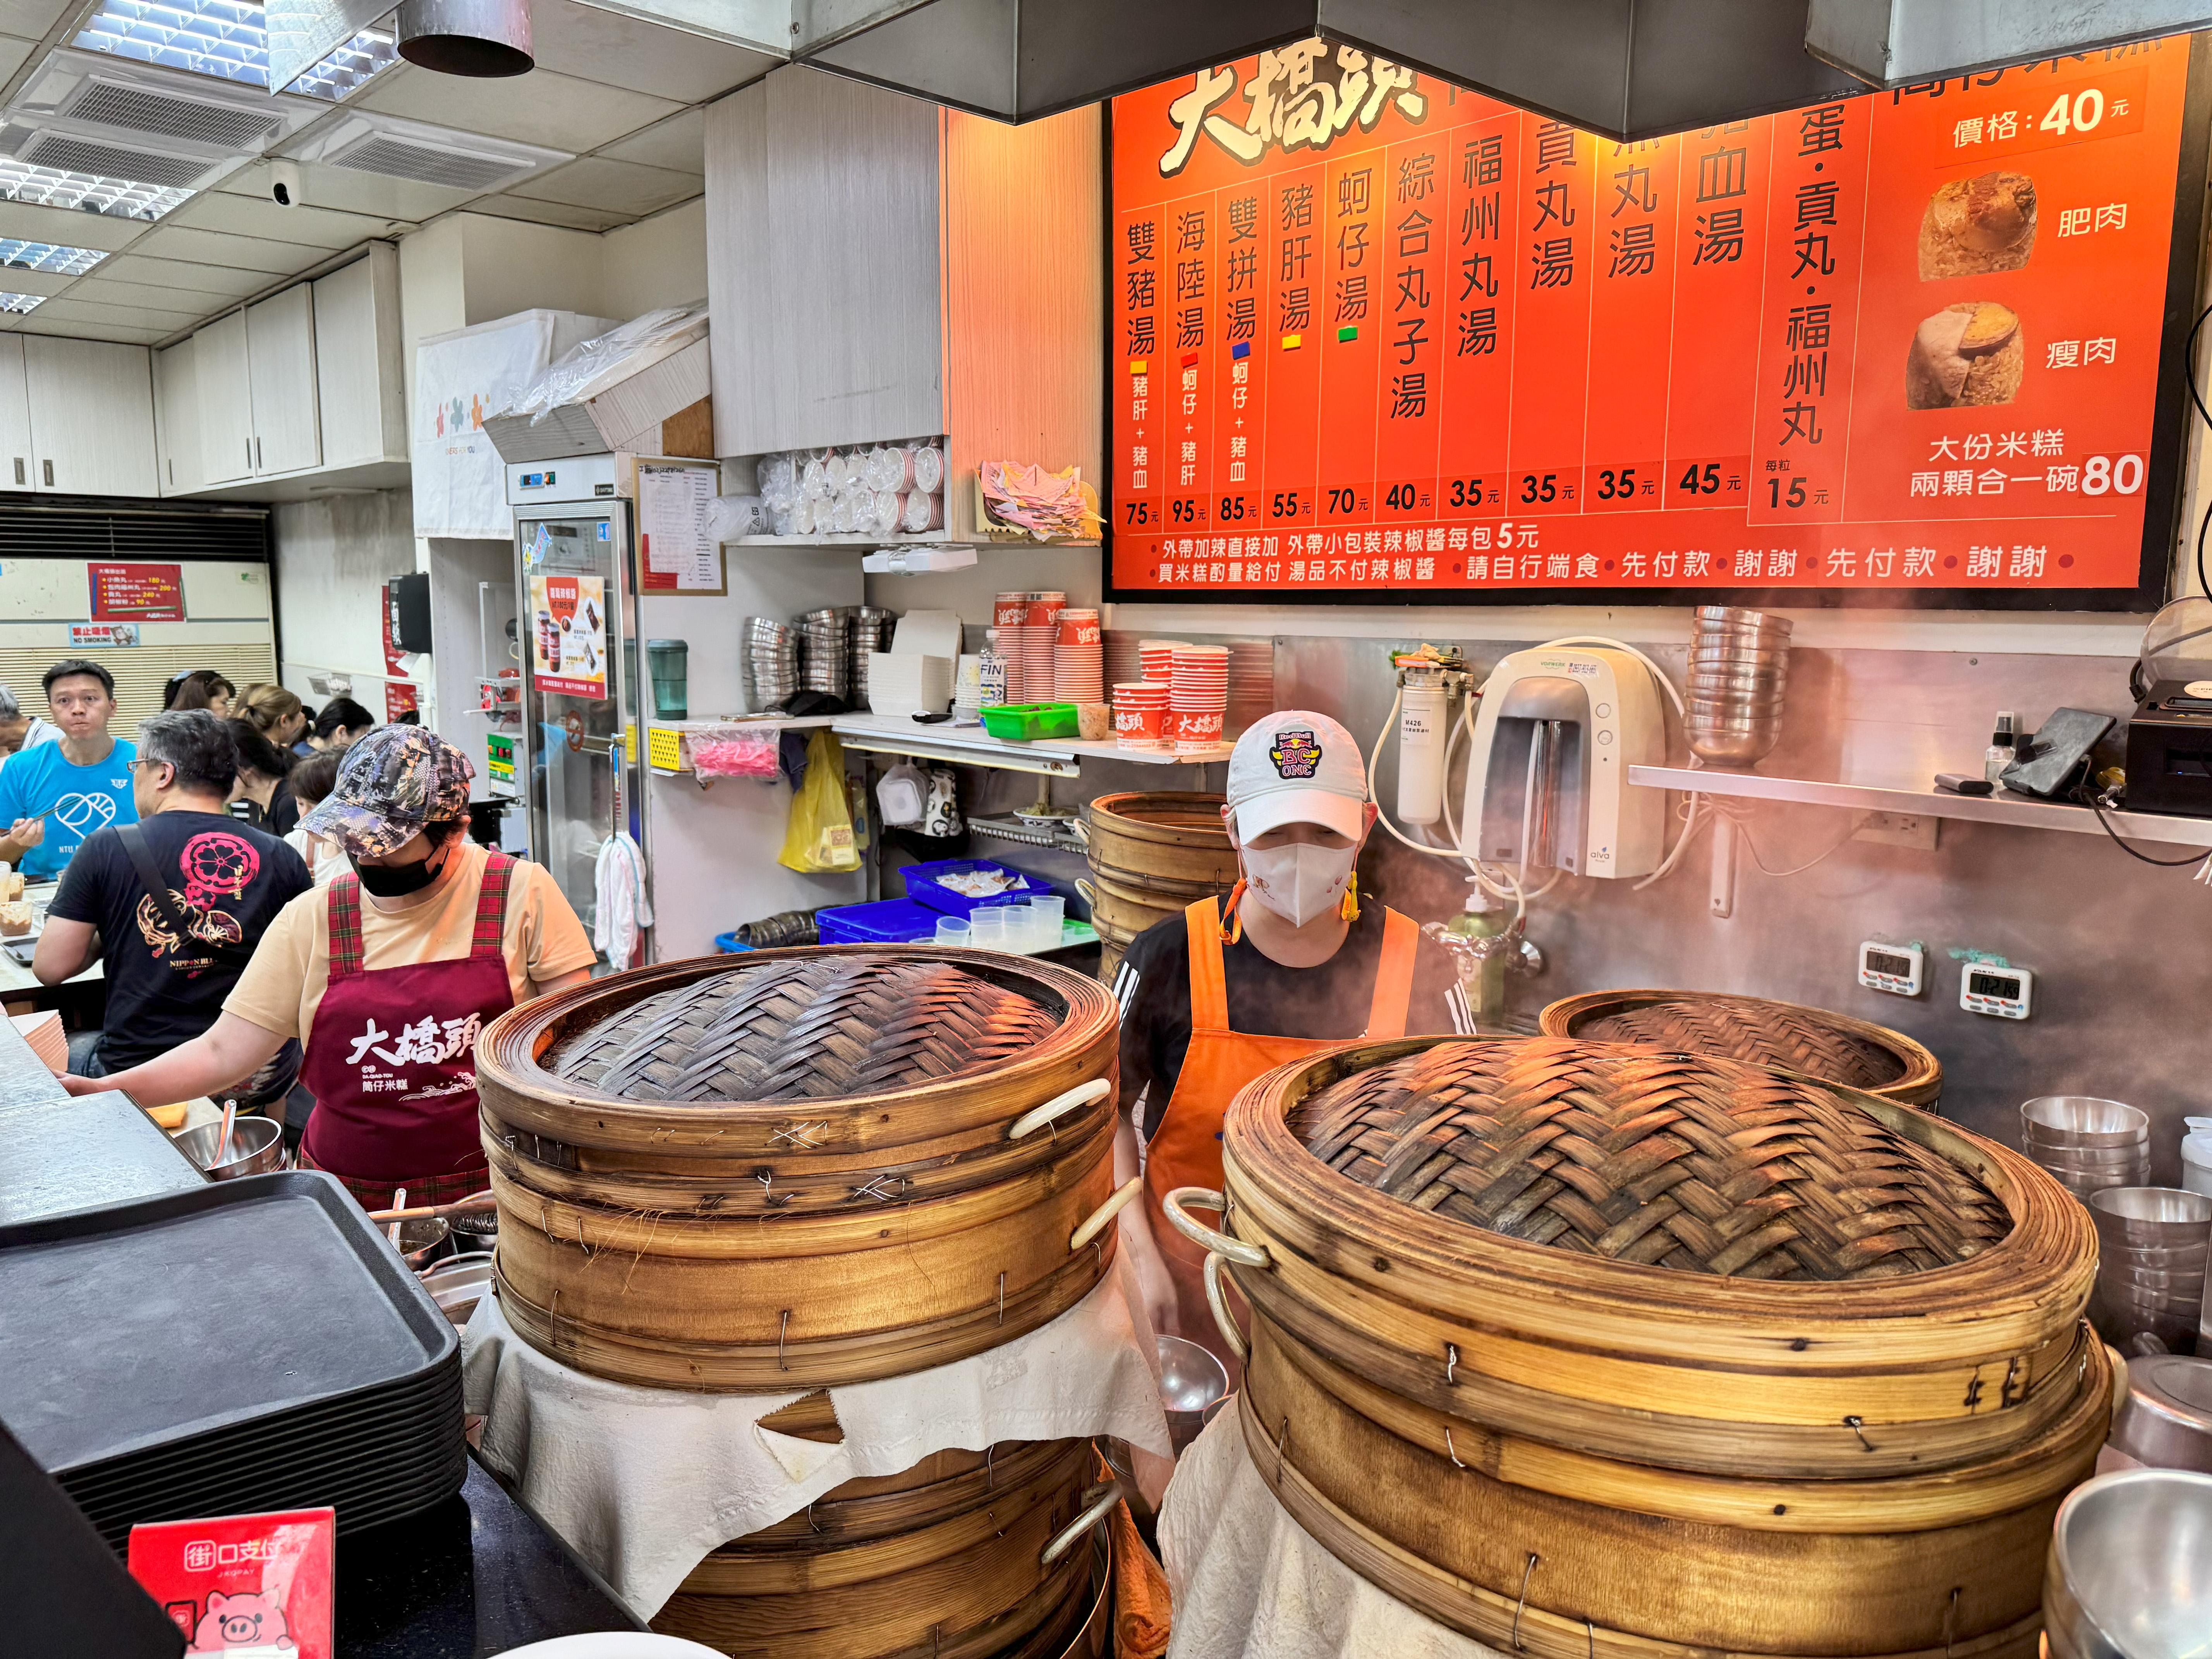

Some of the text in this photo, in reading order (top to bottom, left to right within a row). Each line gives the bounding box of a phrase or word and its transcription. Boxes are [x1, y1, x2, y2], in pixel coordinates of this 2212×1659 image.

[1160, 36, 1424, 173] 大橋頭
[1279, 183, 1313, 332] 豬肝湯
[1334, 168, 1372, 322] 蚵仔湯
[1457, 135, 1502, 357] 福州丸湯
[1530, 121, 1577, 290] 貢丸湯
[1608, 137, 1659, 278] 丸湯
[1693, 118, 1749, 266] 血湯
[2057, 203, 2126, 237] 肥肉
[1127, 221, 1155, 356] 雙豬湯
[1176, 211, 1205, 349] 海陸湯
[1226, 197, 1258, 341] 雙拼湯
[1390, 153, 1436, 419] 綜合丸子湯
[2045, 337, 2116, 369] 瘦肉
[1766, 460, 1790, 472] 每粒
[1929, 429, 2064, 462] 大份米糕
[1159, 545, 2047, 582] 買米糕酌量給付 湯品不付辣椒醬 請自行端食 先付款 謝謝 先付款 謝謝
[1163, 536, 1278, 558] 外帶加辣直接加
[981, 665, 1002, 675] FIN
[1282, 764, 1312, 776] ONE
[346, 1012, 481, 1066] 大橋頭
[362, 1079, 408, 1092] 筒仔米糕
